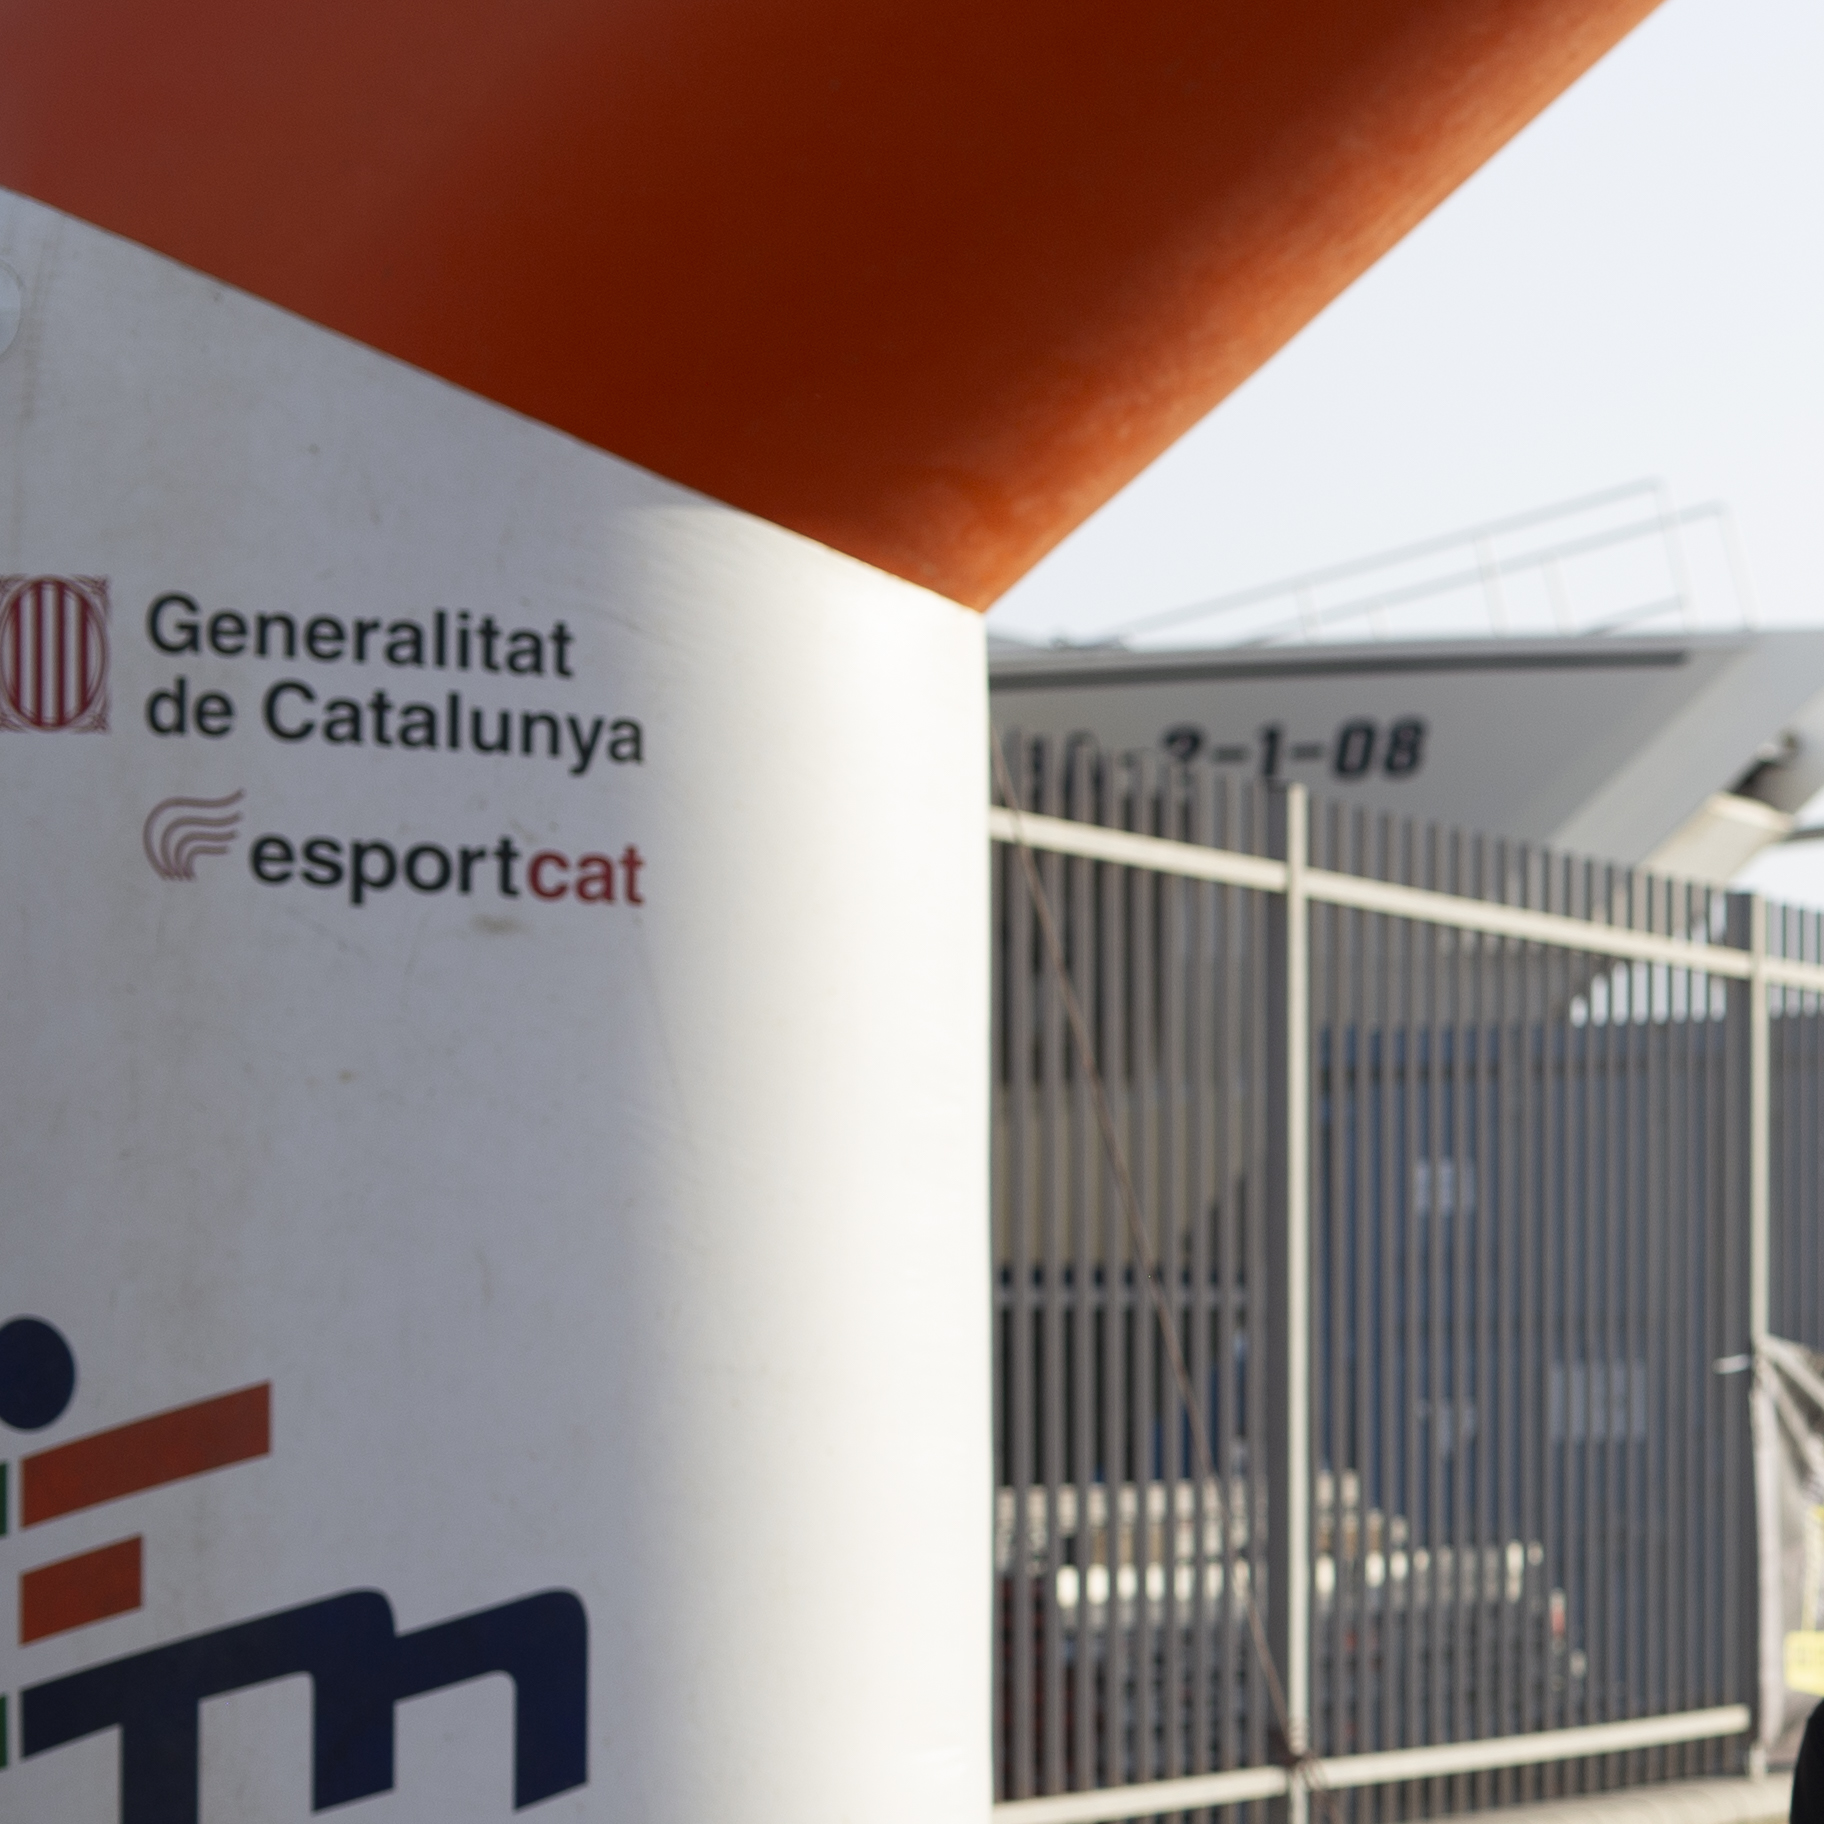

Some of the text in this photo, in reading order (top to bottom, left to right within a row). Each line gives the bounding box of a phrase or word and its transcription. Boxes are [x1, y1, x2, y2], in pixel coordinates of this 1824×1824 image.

[146, 591, 575, 680] Generalitat
[146, 677, 646, 777] de Catalunya
[249, 833, 647, 907] esportcat
